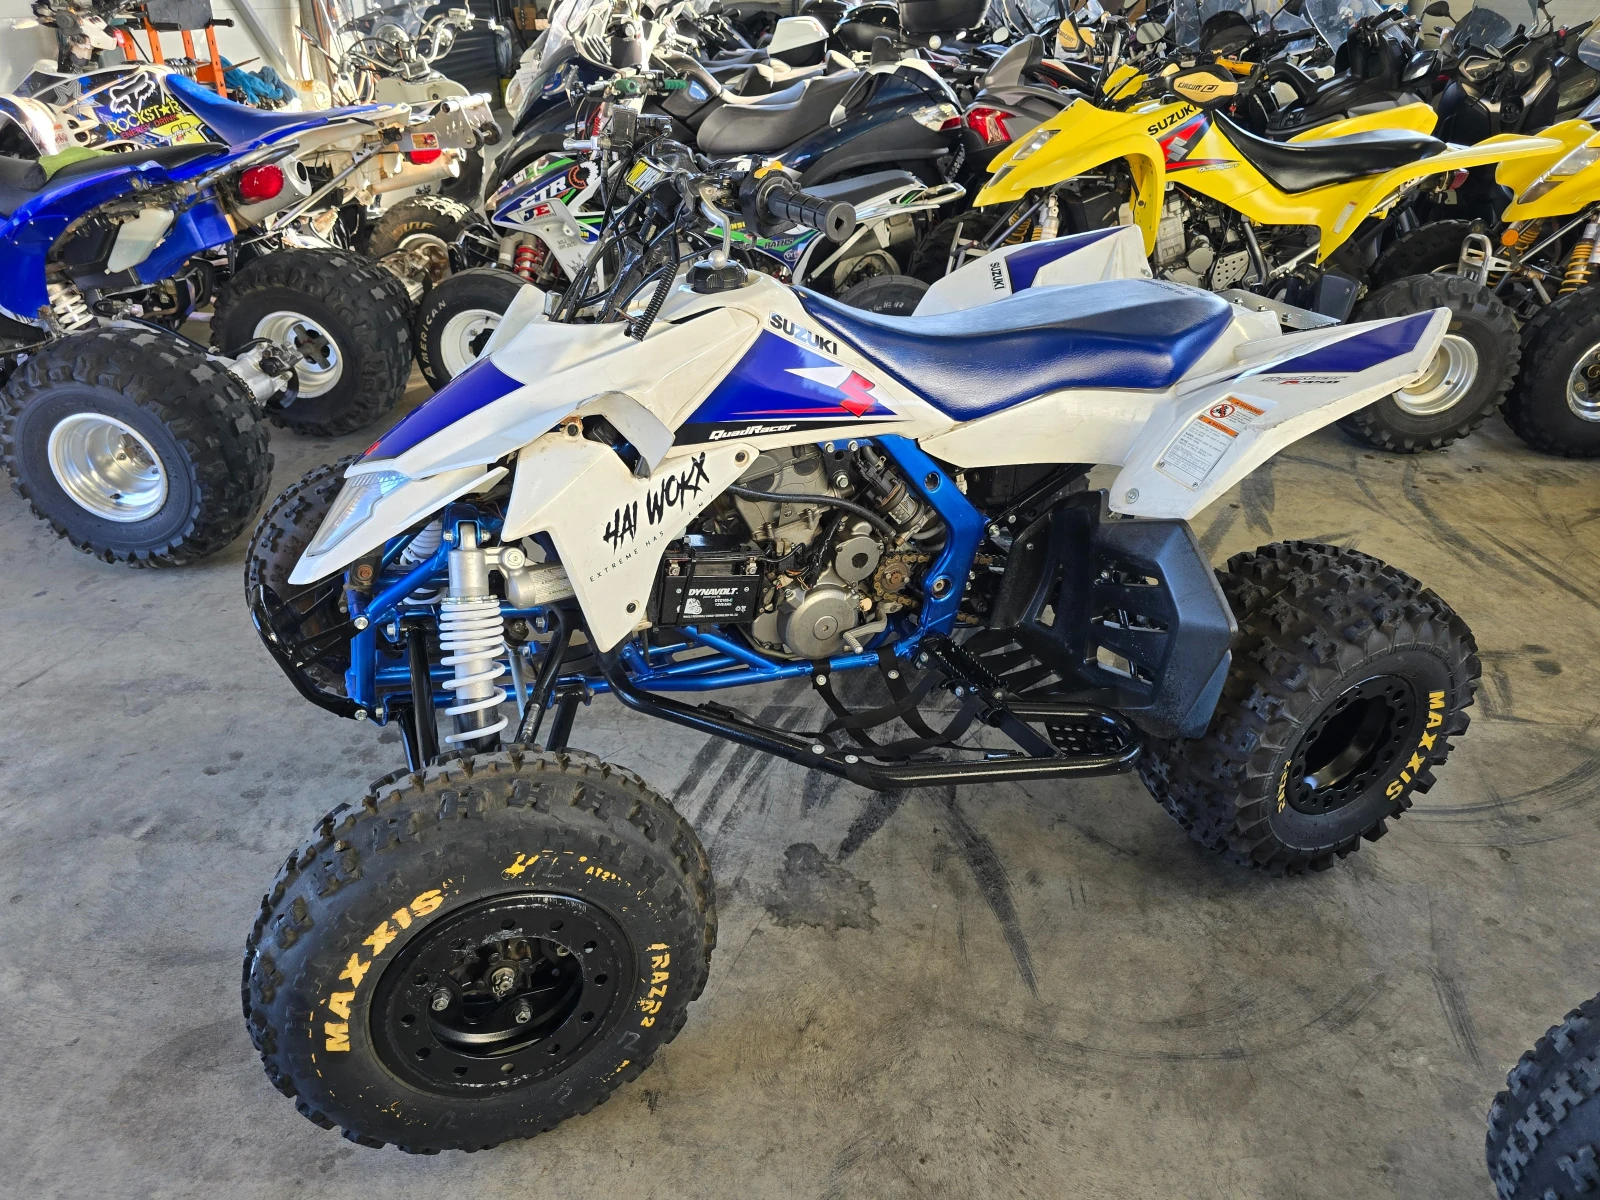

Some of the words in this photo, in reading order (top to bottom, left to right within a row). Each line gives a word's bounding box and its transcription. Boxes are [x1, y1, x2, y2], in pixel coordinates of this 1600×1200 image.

[120, 123, 150, 140] ENERGY
[153, 113, 178, 128] DRINK
[523, 203, 550, 222] JE
[990, 262, 1005, 290] SUZUKI
[420, 299, 447, 380] AMERICAN
[769, 313, 838, 356] SUZUKI
[708, 423, 797, 441] QuadRacer
[589, 547, 639, 583] EXTREME
[645, 530, 664, 548] HAS
[1385, 690, 1446, 801] MAXXIS
[324, 889, 445, 1052] MAXXIS
